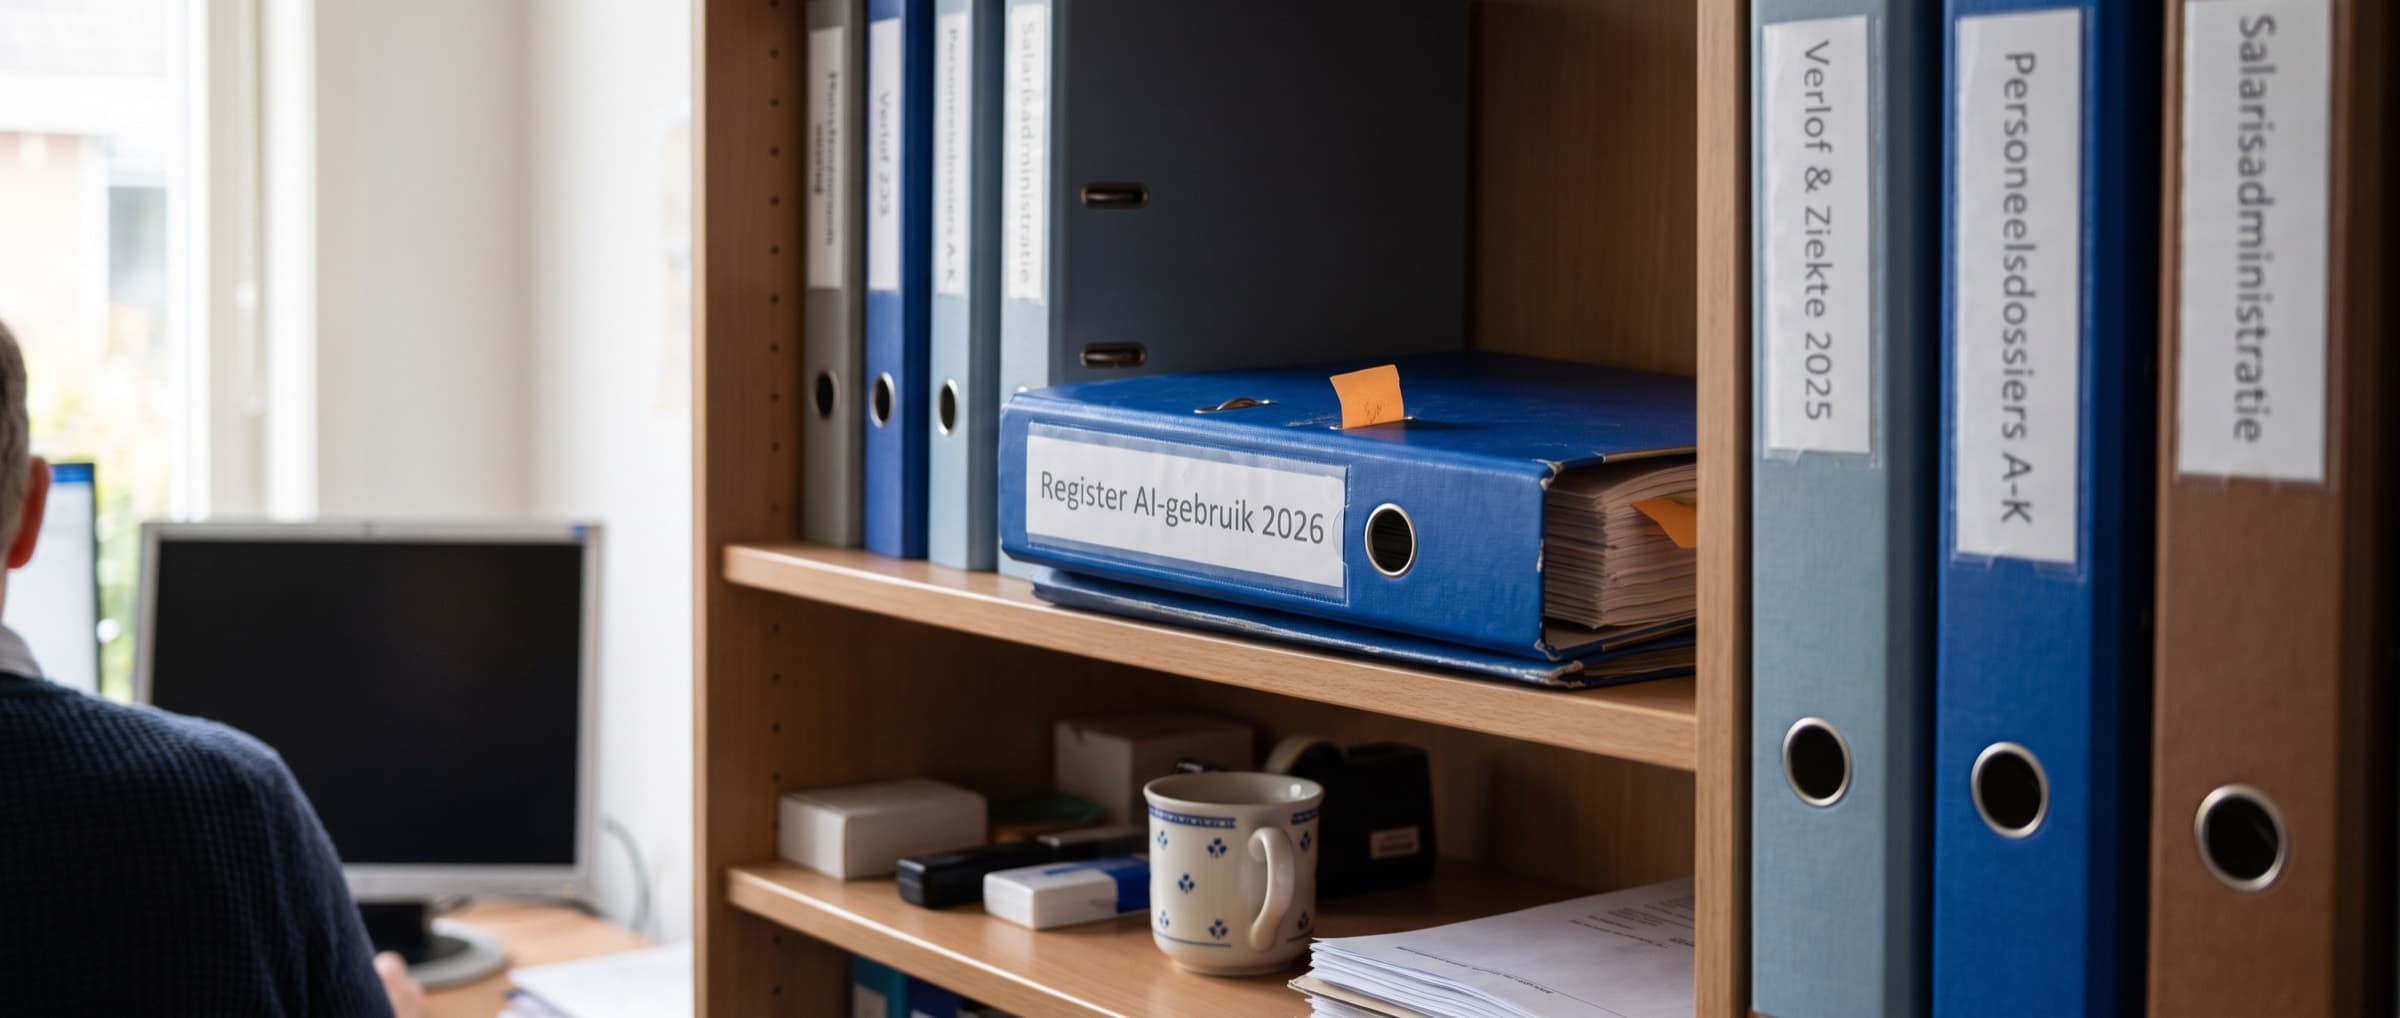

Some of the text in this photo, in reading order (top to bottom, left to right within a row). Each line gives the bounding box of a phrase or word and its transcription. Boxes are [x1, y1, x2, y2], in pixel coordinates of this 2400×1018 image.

[1020, 22, 1034, 284] Salarisadministratie
[1804, 40, 1833, 421] Verlof & Ziekte 2025
[2001, 52, 2037, 524] Personeelsdossiers A-K
[2233, 14, 2277, 443] Salarisadministratie
[1041, 471, 1324, 545] Register AI-gebruik 2026
